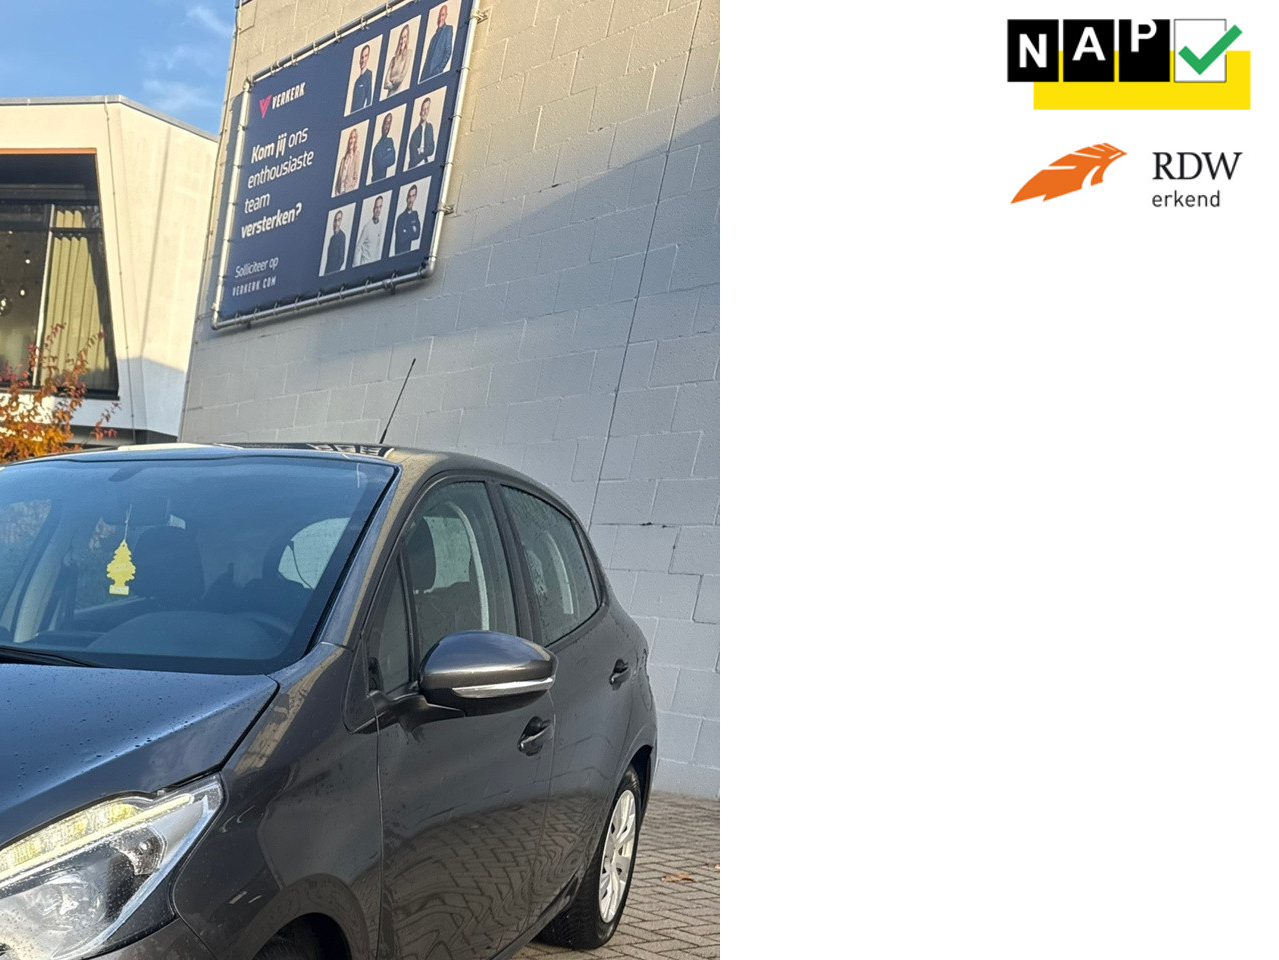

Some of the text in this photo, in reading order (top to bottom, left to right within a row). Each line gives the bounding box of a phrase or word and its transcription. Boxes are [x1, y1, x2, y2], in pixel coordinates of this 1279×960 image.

[271, 82, 306, 110] VERKERK
[251, 127, 309, 164] Kom jij ons
[247, 151, 315, 189] enthousiaste
[244, 193, 271, 214] team
[241, 202, 303, 239] versterken?
[234, 257, 279, 279] Solliciteer op
